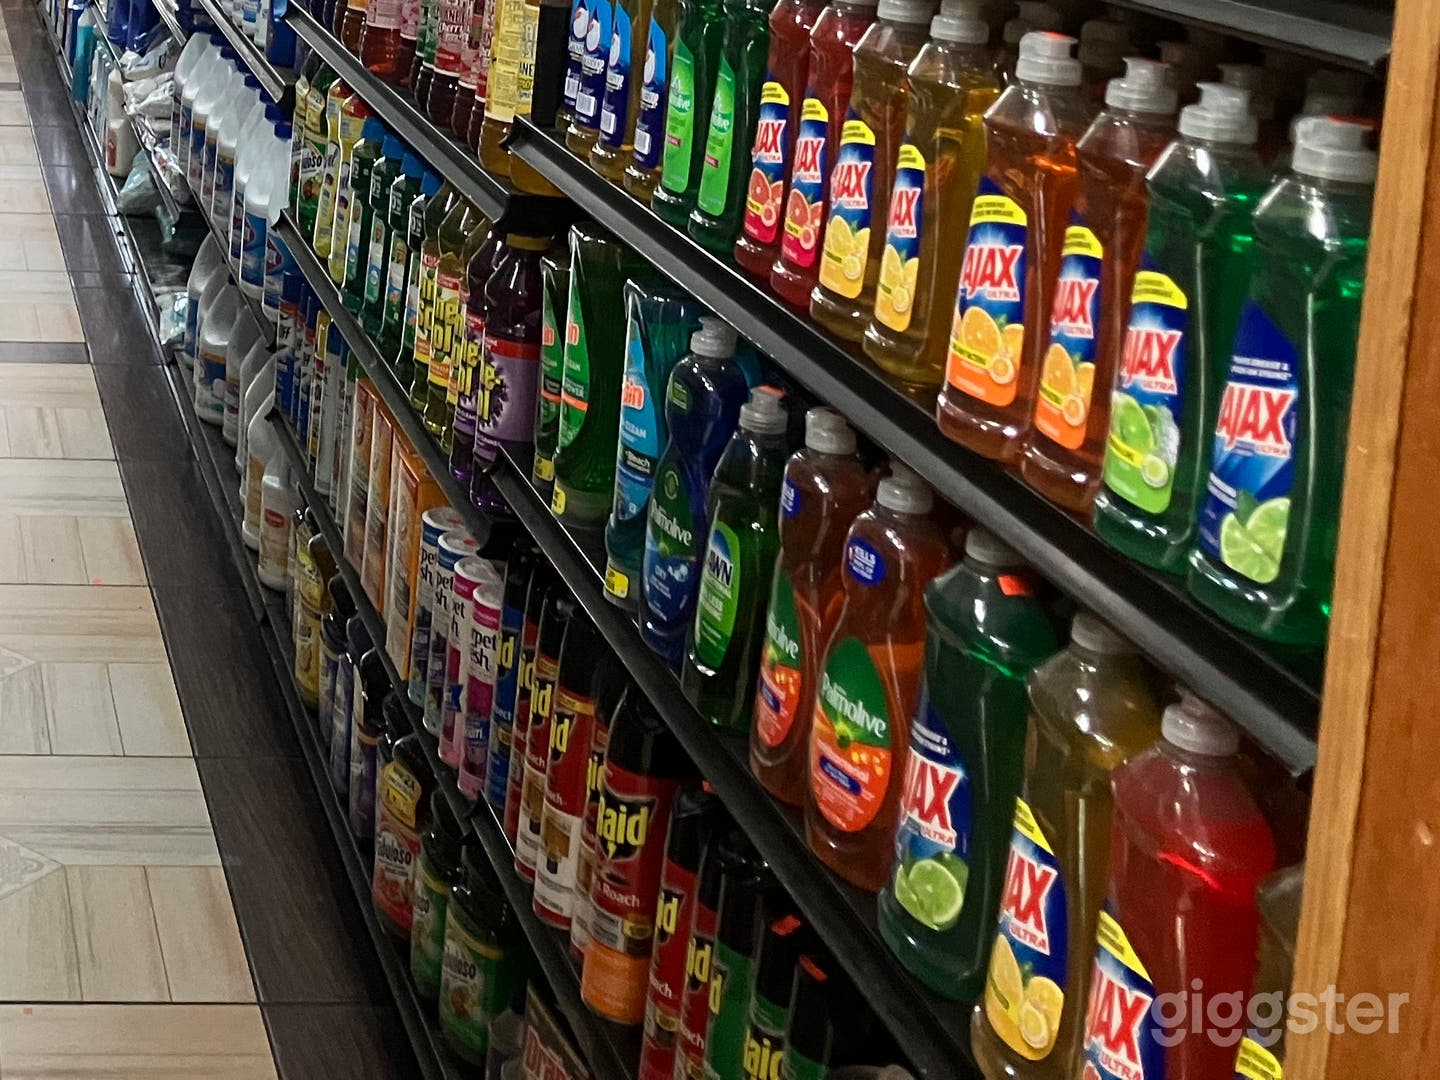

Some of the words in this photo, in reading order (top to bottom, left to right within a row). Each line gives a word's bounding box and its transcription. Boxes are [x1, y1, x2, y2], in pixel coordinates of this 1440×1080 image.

[962, 246, 1020, 298] AJAX
[986, 290, 1020, 301] ULTRA
[1216, 382, 1295, 450] AJAX
[651, 497, 692, 548] Palmolive
[821, 672, 889, 739] Palmolive
[596, 794, 650, 861] Raid
[920, 825, 956, 847] ULTRA
[602, 882, 640, 910] Roach
[1011, 924, 1049, 954] ULTRA
